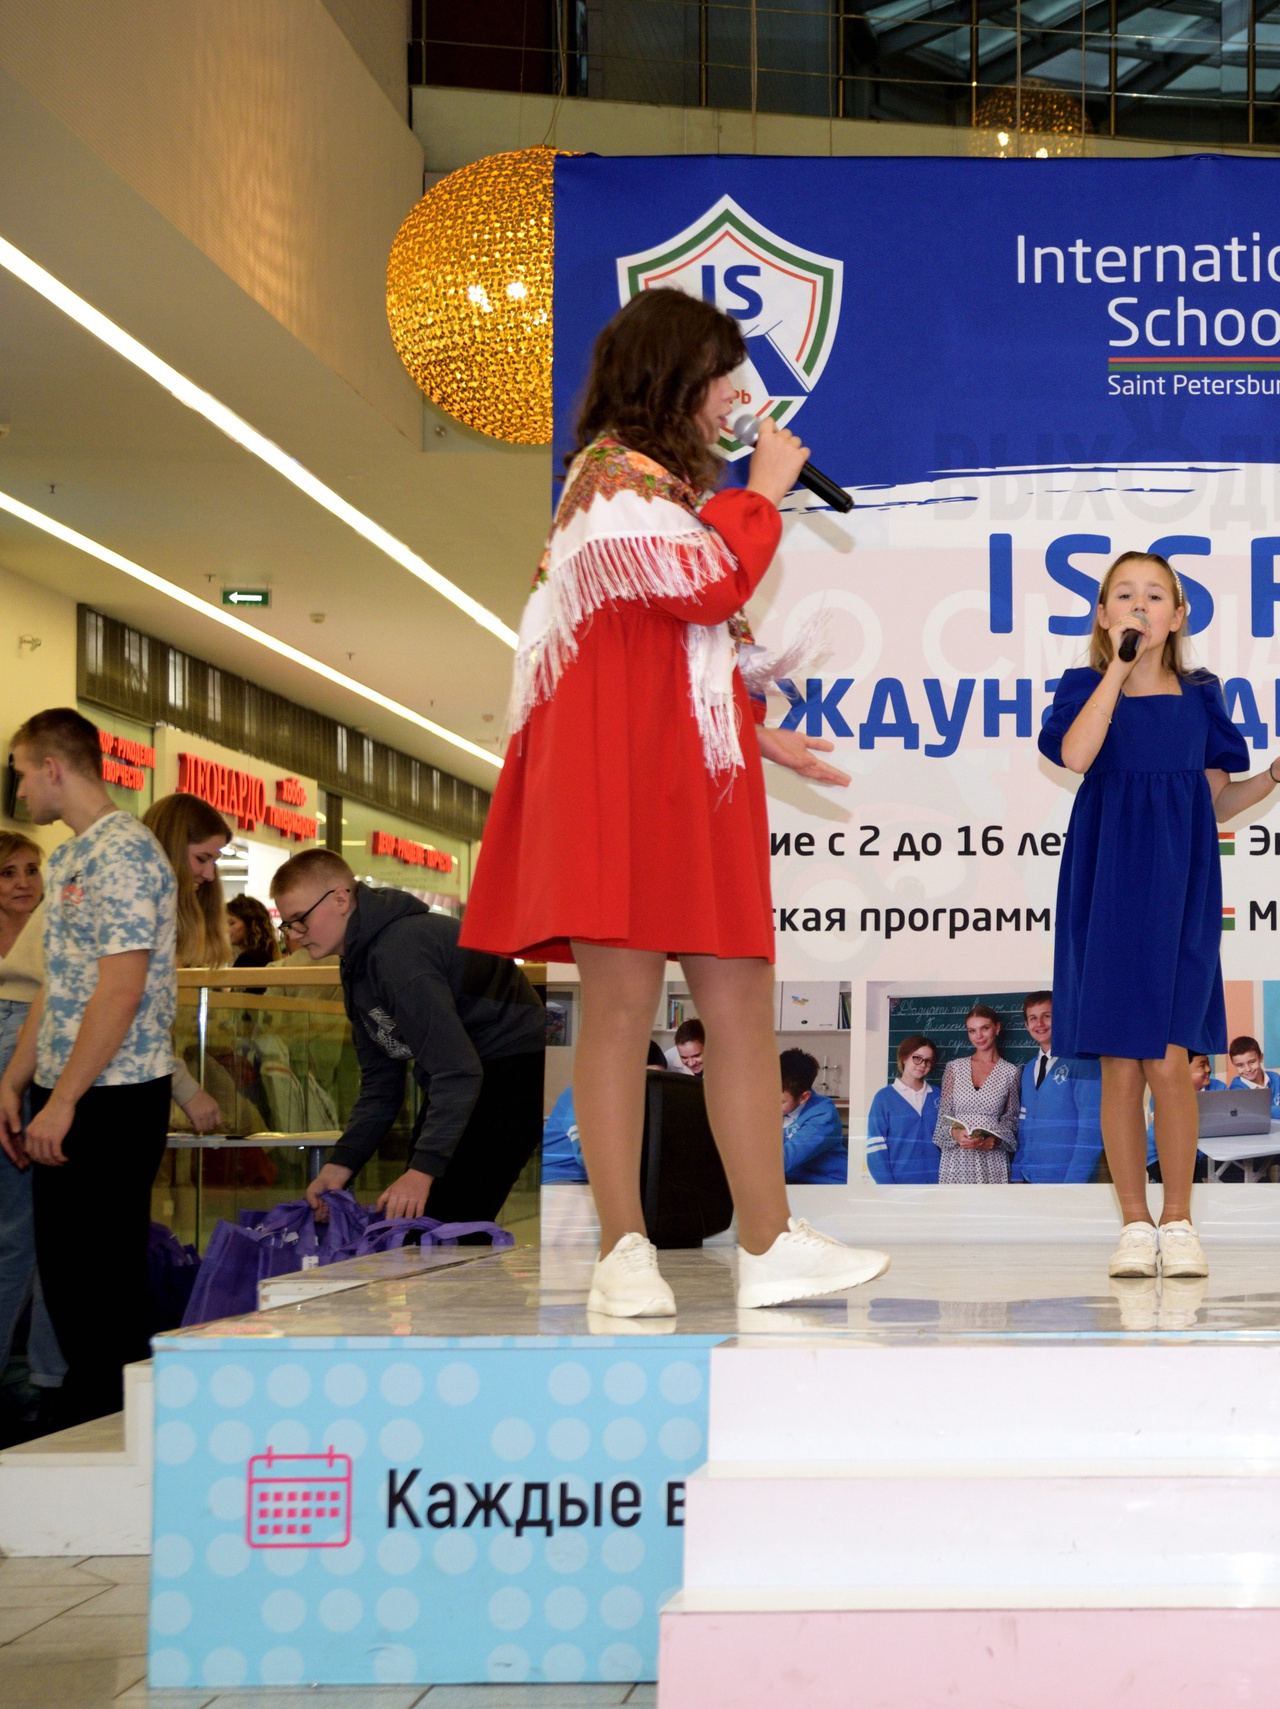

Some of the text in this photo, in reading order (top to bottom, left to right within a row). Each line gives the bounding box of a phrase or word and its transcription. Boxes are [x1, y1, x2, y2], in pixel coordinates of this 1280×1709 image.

[701, 264, 764, 321] IS
[1107, 374, 1167, 396] Saint
[98, 729, 114, 755] КОР
[180, 752, 267, 832] ЛЕОНАРДО
[827, 831, 846, 857] с
[858, 824, 881, 857] 2
[892, 831, 943, 862] до
[956, 824, 1005, 857] 16
[859, 906, 1054, 940] программ
[385, 1467, 642, 1537] Каждые
